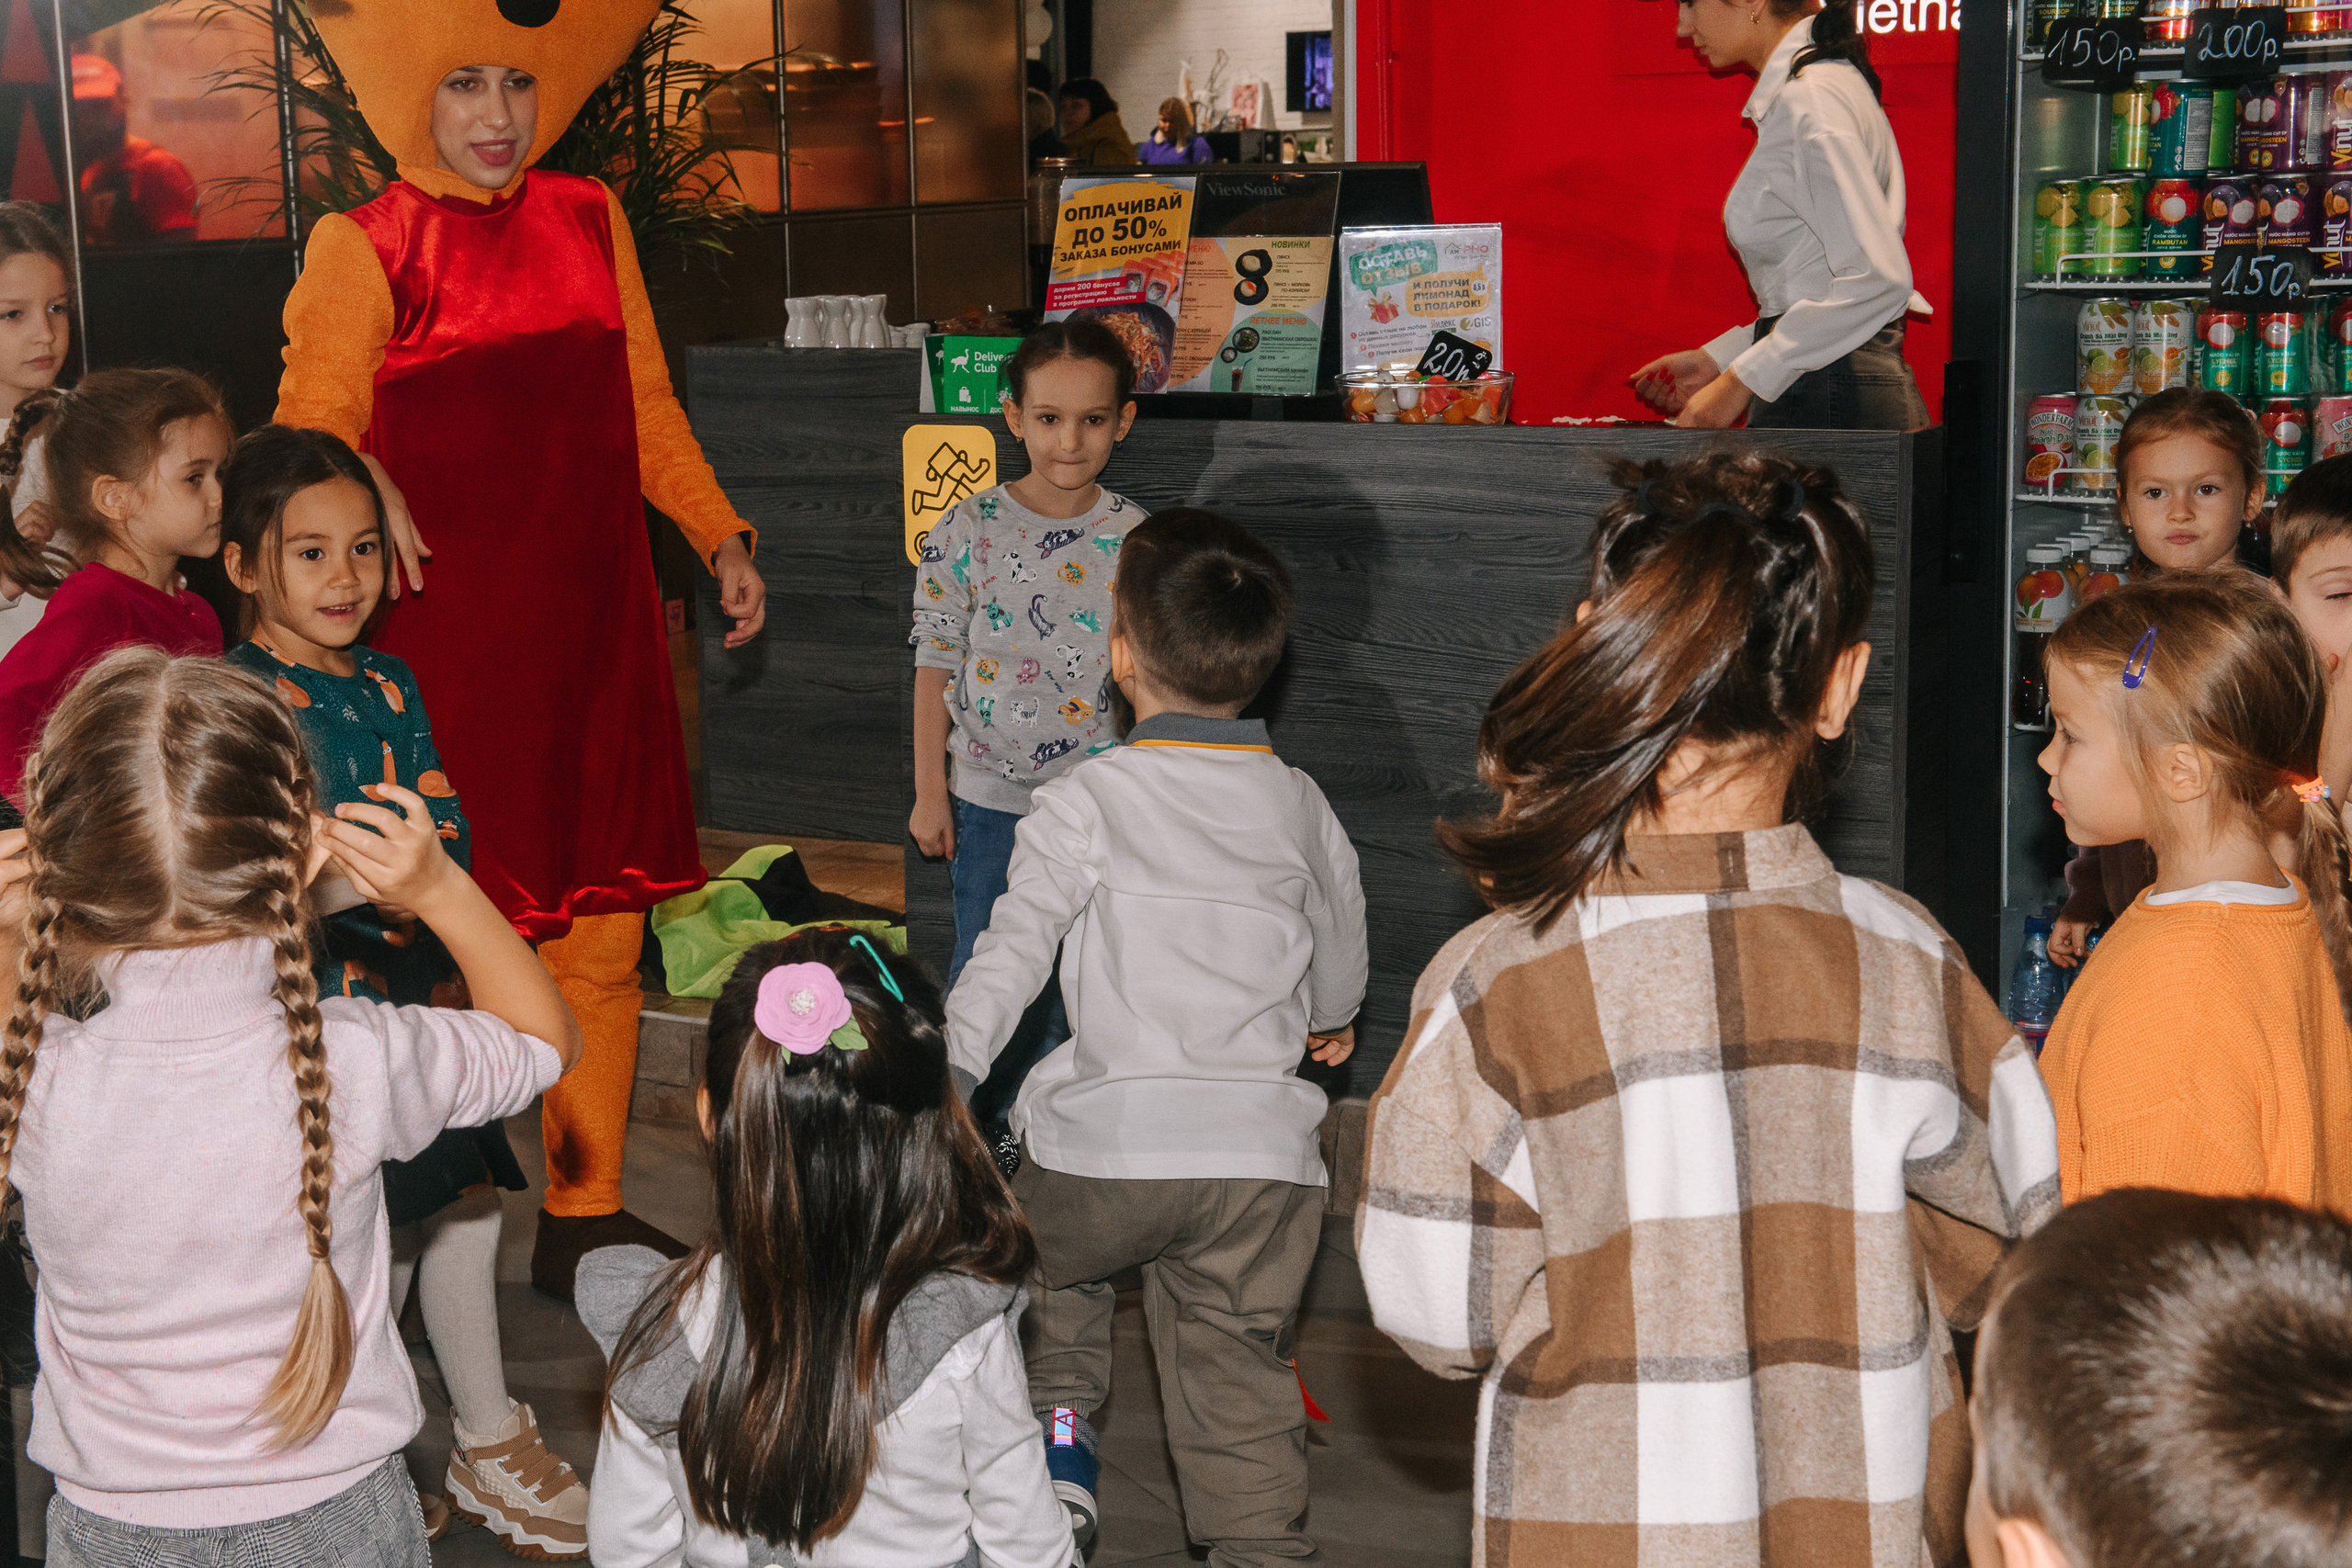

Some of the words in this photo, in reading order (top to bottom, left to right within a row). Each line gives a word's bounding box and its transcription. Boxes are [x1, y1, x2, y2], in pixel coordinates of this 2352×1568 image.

[2198, 20, 2278, 65] 200р.
[2048, 28, 2136, 72] 150р.
[1206, 182, 1287, 197] ViewSonic
[1064, 191, 1182, 221] ОПЛАЧИВАЙ
[1071, 227, 1104, 249] ДО
[1112, 216, 1167, 241] 50%
[1059, 248, 1107, 262] ЗАКАЗА
[1111, 240, 1181, 256] БОНУСАМИ
[1358, 245, 1428, 269] ОСТАВЬ
[1362, 262, 1422, 285] ОТЗЫВ
[2222, 254, 2306, 299] 150р.
[1053, 286, 1076, 294] дарим
[1077, 282, 1091, 290] 200
[1092, 281, 1120, 289] бонусов
[1424, 278, 1469, 289] ПОЛУЧИ
[1058, 299, 1095, 308] программе
[1096, 295, 1136, 303] лояльности
[1063, 290, 1107, 300] регистрацию
[1413, 289, 1469, 300] ЛИМОНАД
[1414, 303, 1421, 311] В
[1424, 299, 1481, 311] ПОДАРОК!
[1250, 317, 1280, 325] ЛЕТНЕЕ
[1282, 317, 1307, 325] МЕНЮ
[1430, 319, 1456, 329] Яндекс
[974, 363, 997, 373] Club
[2029, 412, 2075, 429] WONDERFARM
[2335, 417, 2352, 431] WON
